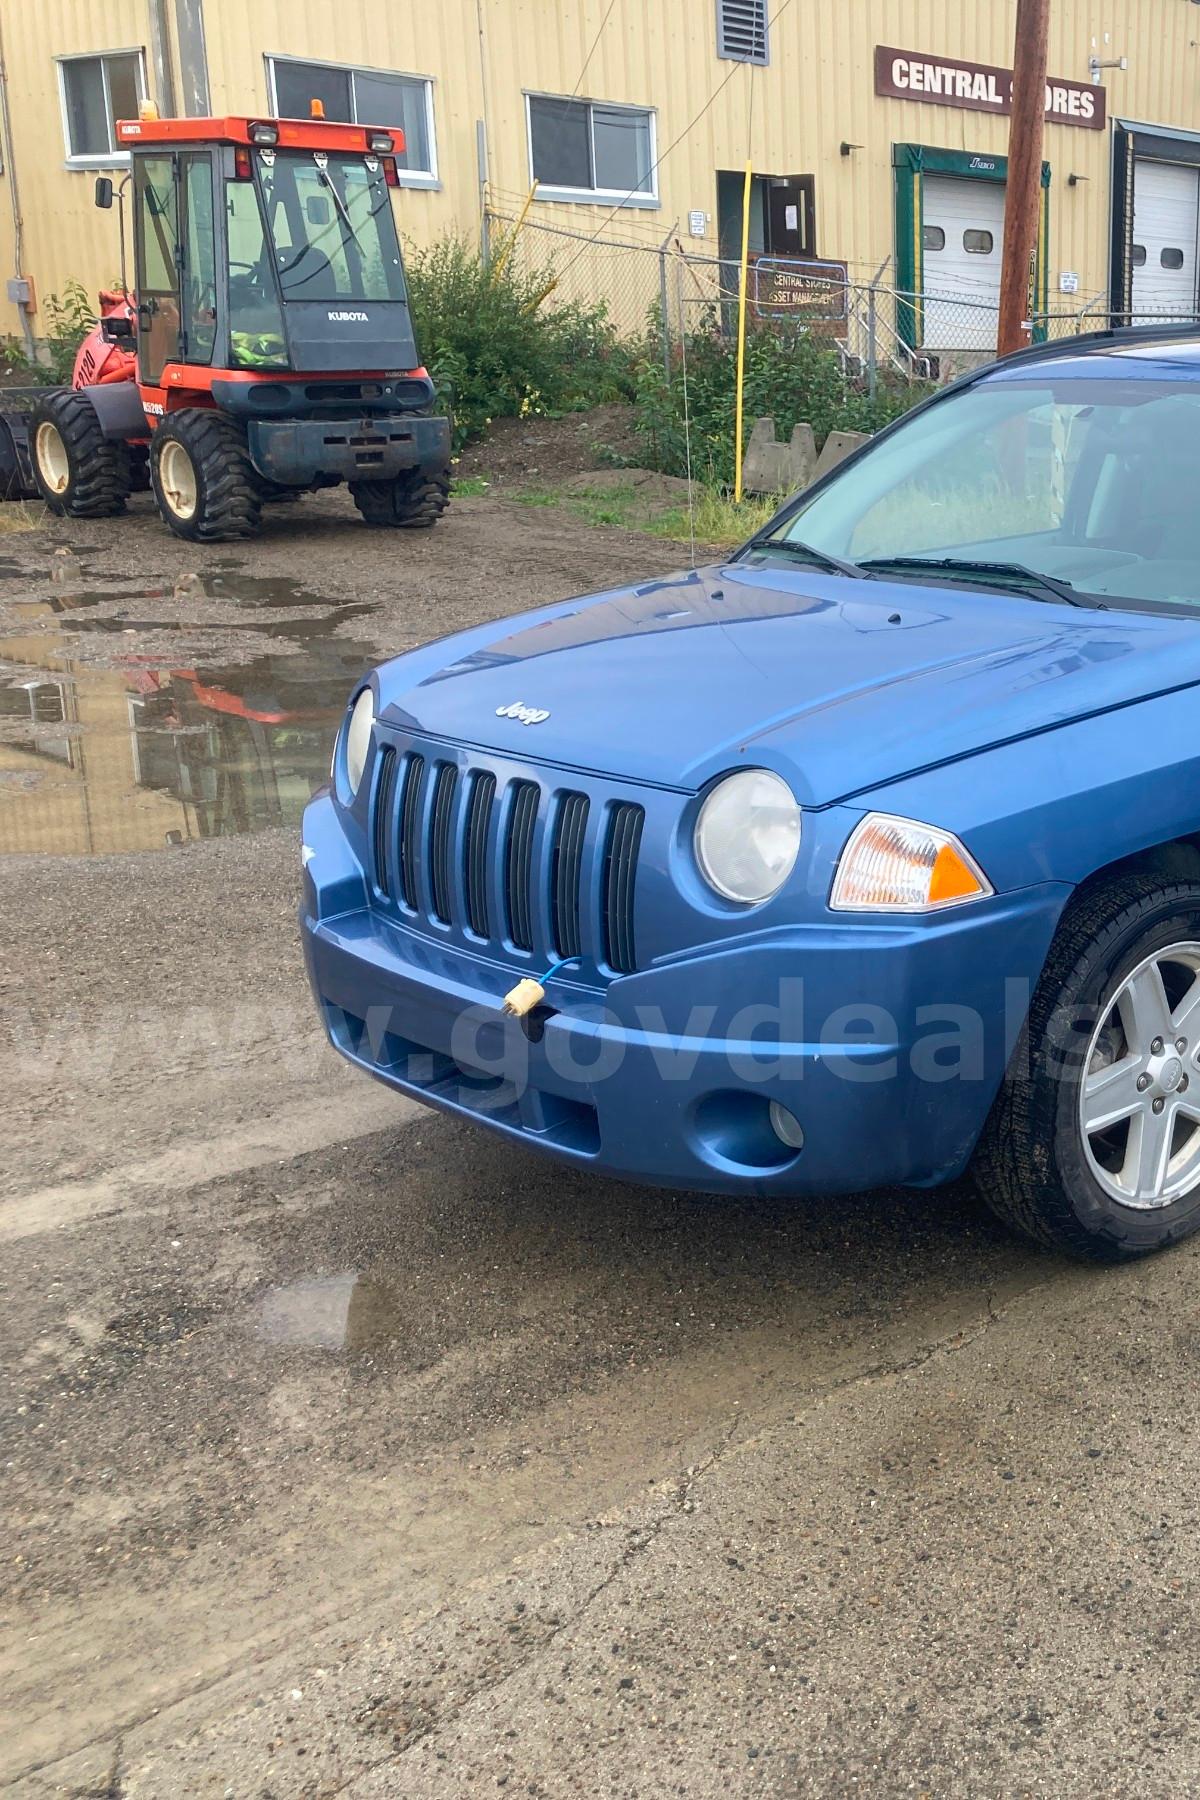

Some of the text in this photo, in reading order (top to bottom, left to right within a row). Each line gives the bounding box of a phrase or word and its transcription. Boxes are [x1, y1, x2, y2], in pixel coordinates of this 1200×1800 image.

[892, 58, 1095, 119] CENTRAL ORES
[774, 274, 803, 288] CENTRAL
[327, 311, 369, 321] KUBOTA
[495, 701, 551, 726] Jeep
